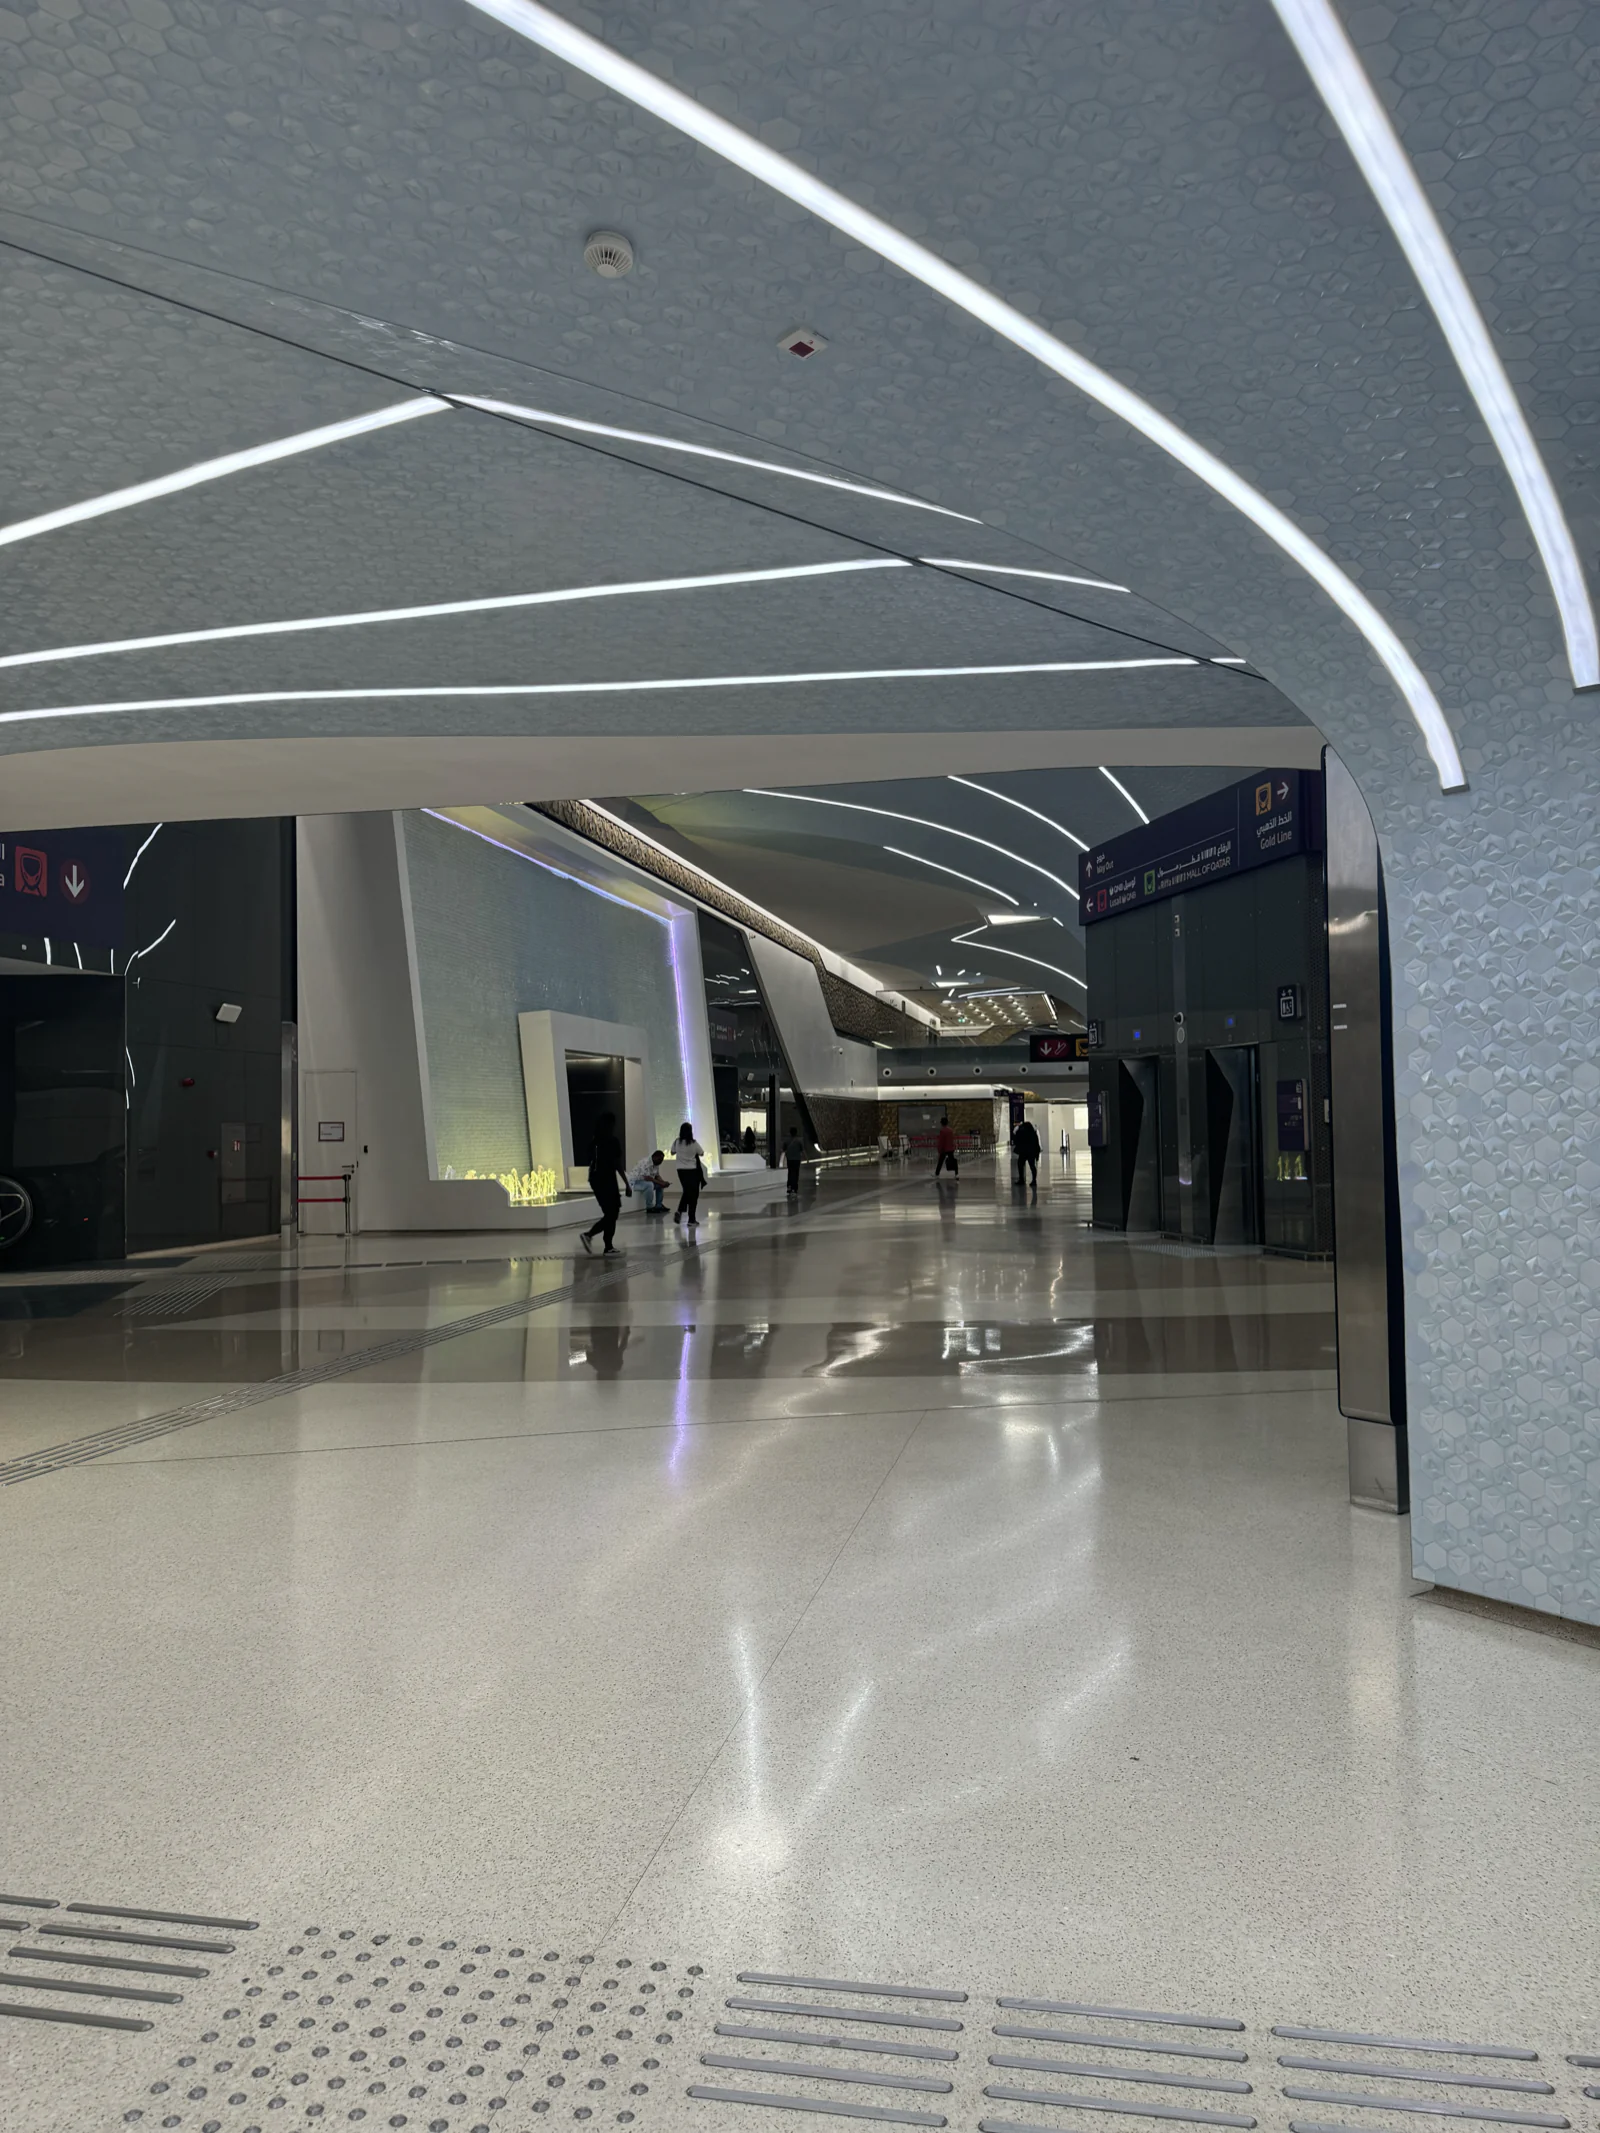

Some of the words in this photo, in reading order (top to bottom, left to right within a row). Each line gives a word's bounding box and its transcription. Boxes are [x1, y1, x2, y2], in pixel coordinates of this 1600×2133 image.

[1278, 810, 1292, 826] الخط
[1256, 817, 1277, 838] الذهبي
[1260, 833, 1276, 849] Gold
[1277, 830, 1292, 844] Line
[1096, 865, 1105, 874] Way
[1106, 861, 1114, 870] Out
[1186, 867, 1202, 880] MALL
[1202, 864, 1210, 874] OF
[1210, 856, 1231, 871] QATAR
[1110, 896, 1121, 908] Lusail
[1127, 891, 1136, 901] QNB
